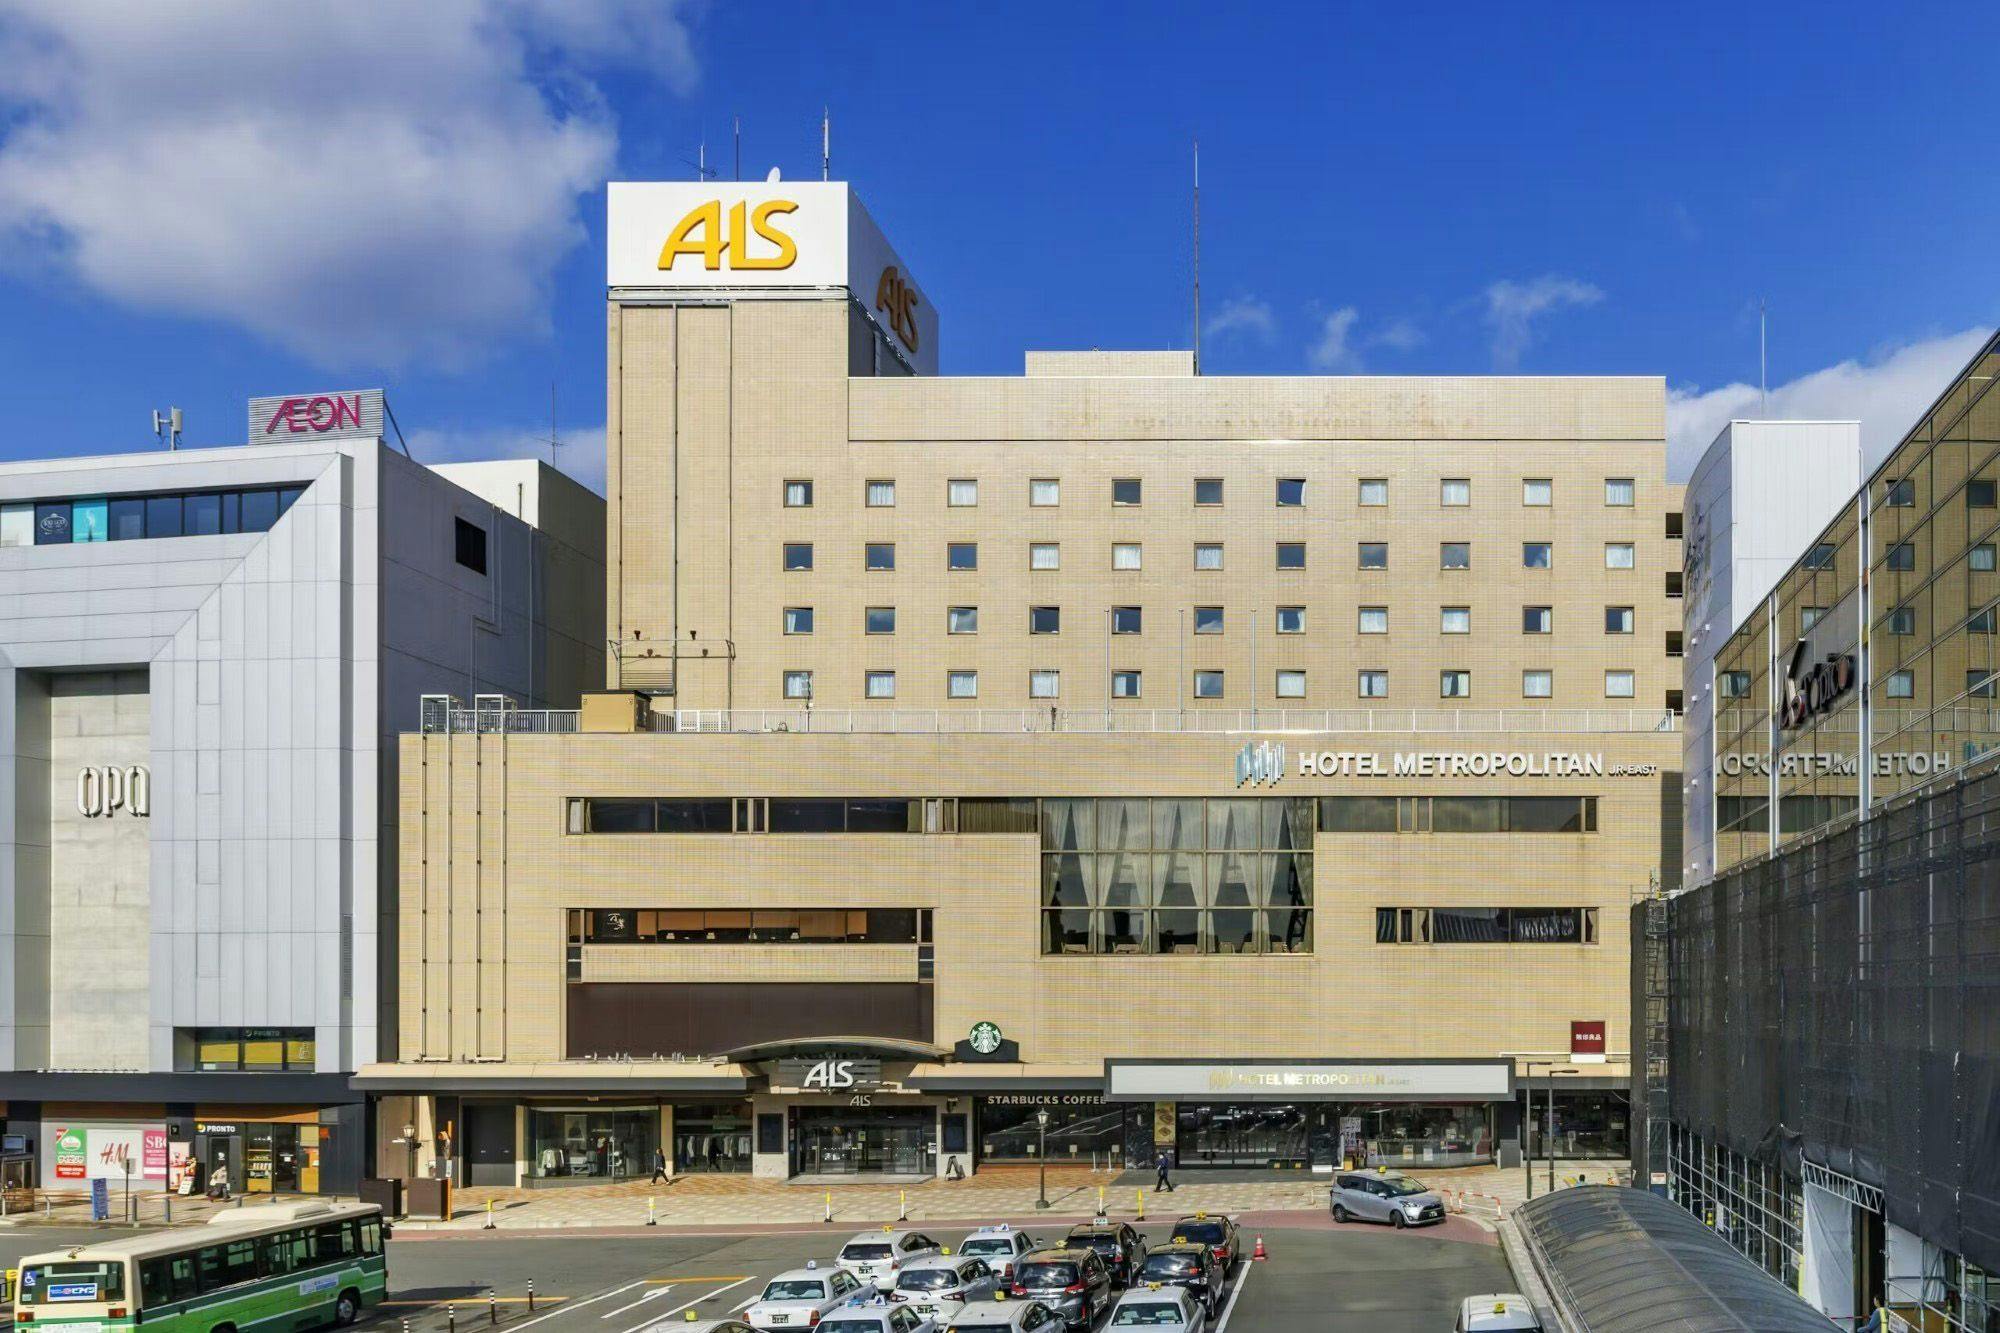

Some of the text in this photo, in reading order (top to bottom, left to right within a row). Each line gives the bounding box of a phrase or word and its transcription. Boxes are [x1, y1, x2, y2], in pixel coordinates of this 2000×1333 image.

[1299, 752, 1657, 777] HOTEL METROPOLITAN JR-EAST
[987, 1095, 1060, 1105] STARBUCKS
[206, 1125, 236, 1133] PRONTO
[99, 1142, 130, 1165] H&M
